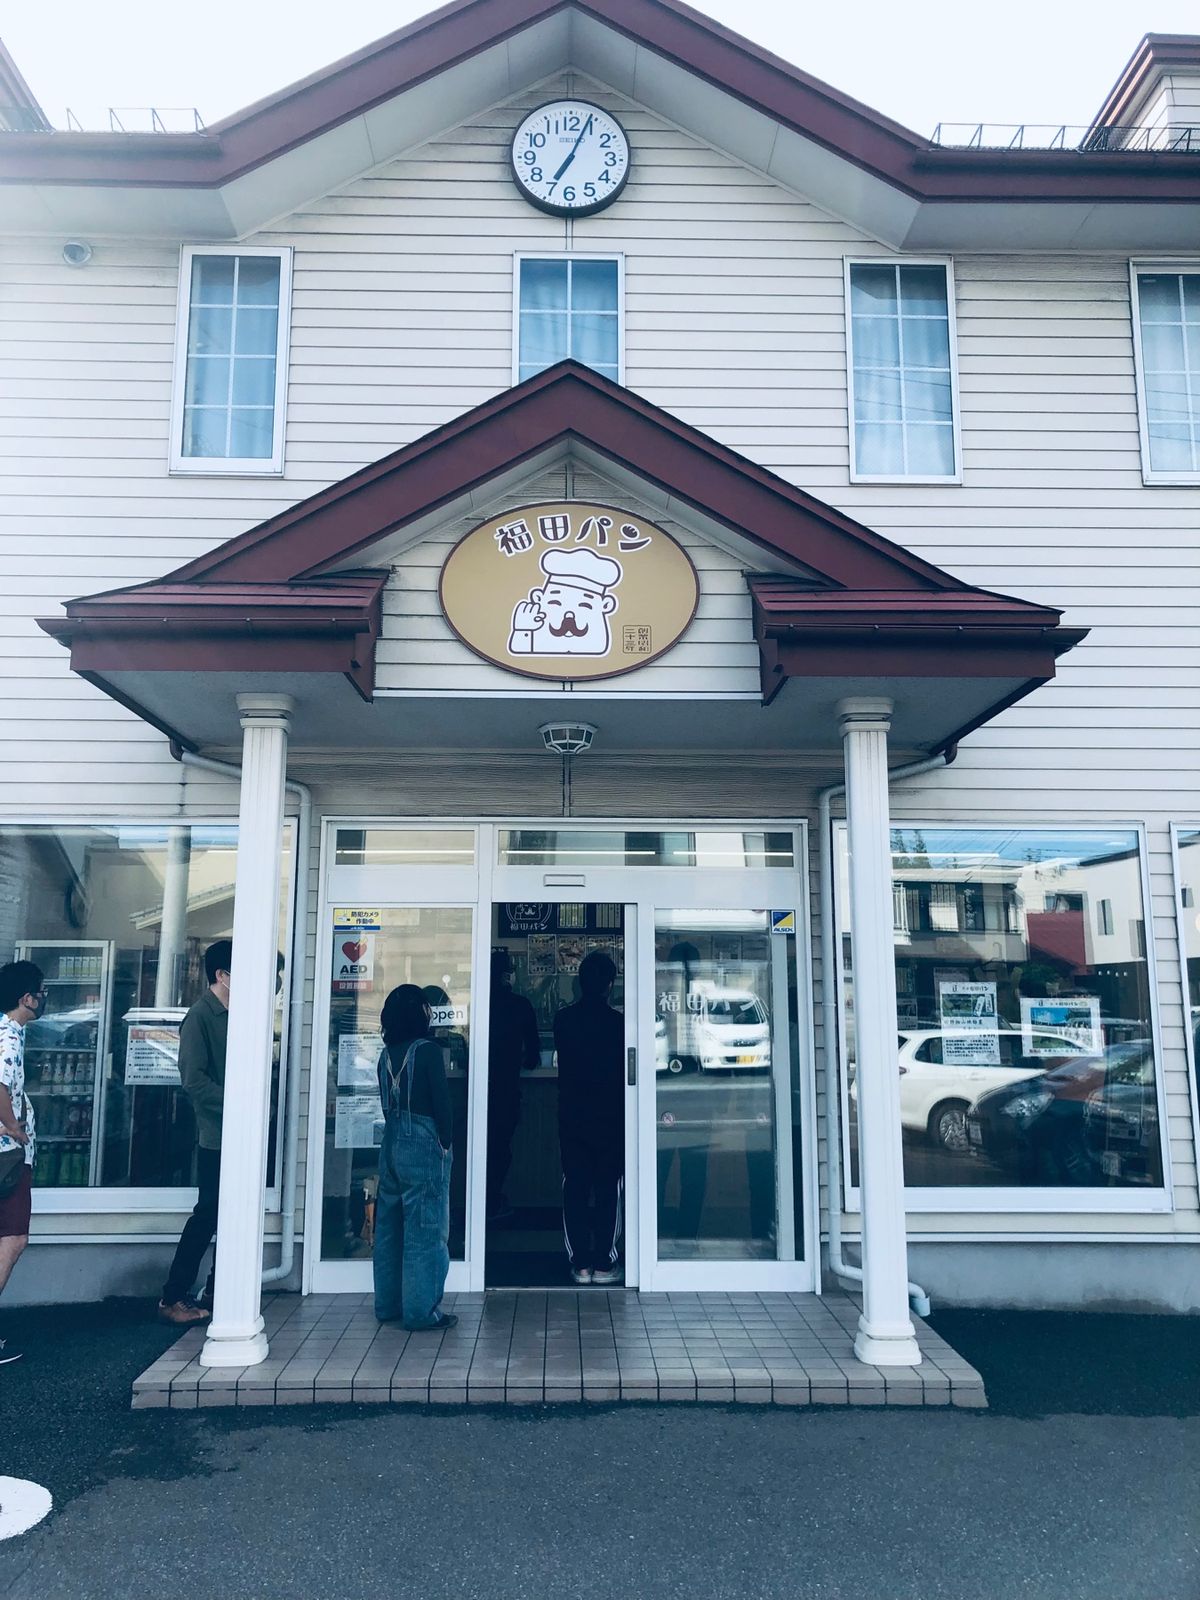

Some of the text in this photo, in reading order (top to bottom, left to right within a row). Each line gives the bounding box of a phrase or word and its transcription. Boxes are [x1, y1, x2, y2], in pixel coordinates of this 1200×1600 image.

[546, 119, 559, 135] 11
[563, 116, 580, 131] 12
[529, 132, 546, 148] 10
[599, 133, 611, 148] 2
[523, 150, 536, 166] 9
[604, 151, 617, 167] 3
[530, 167, 543, 182] 8
[598, 169, 611, 184] 4
[545, 181, 558, 196] 7
[563, 186, 576, 201] 6
[583, 182, 596, 197] 5
[494, 513, 652, 557] 福田パン
[340, 964, 368, 974] AED
